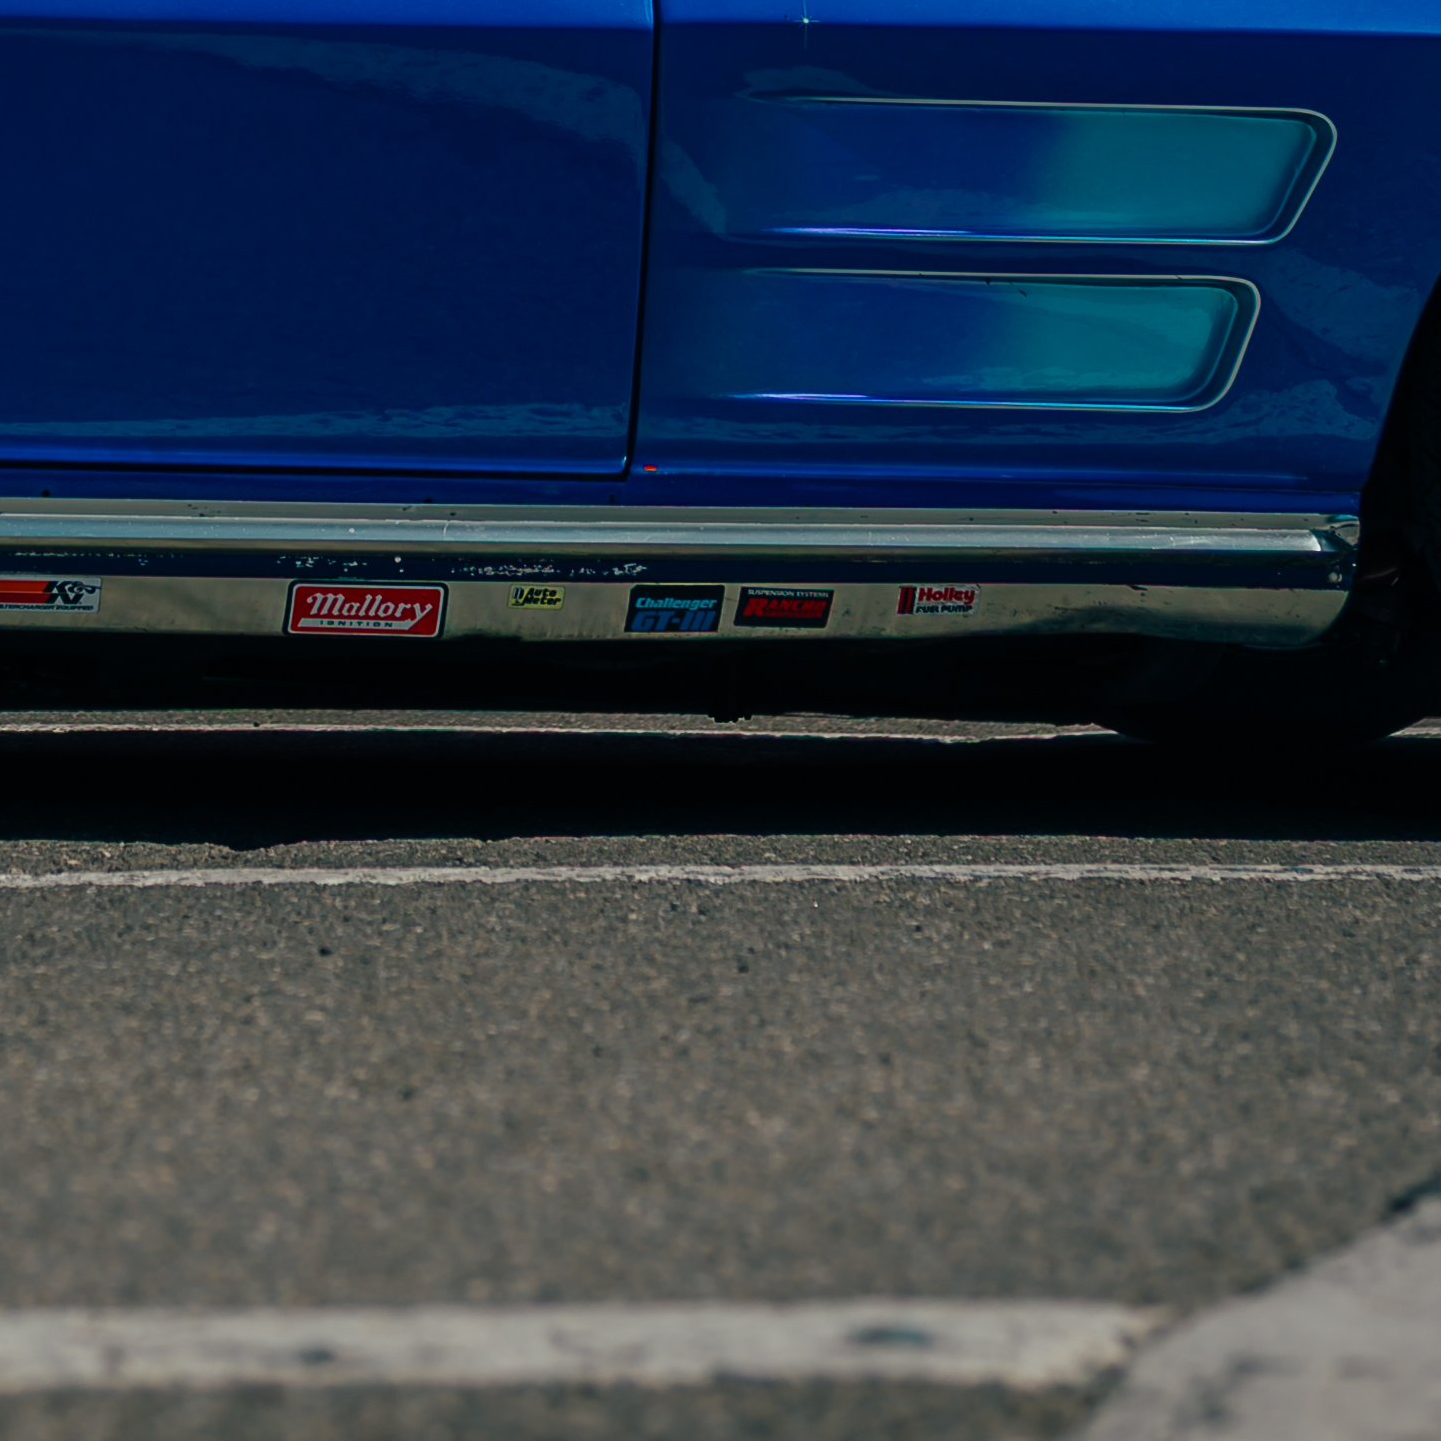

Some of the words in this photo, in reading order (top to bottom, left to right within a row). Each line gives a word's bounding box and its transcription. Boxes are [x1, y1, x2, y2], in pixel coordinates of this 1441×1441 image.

[526, 587, 558, 598] Auto
[918, 586, 975, 606] Holley
[306, 592, 433, 622] Mallory
[523, 597, 561, 606] Meter
[635, 597, 717, 611] Challenger
[915, 605, 939, 614] FUEL
[319, 619, 394, 628] IGNITION
